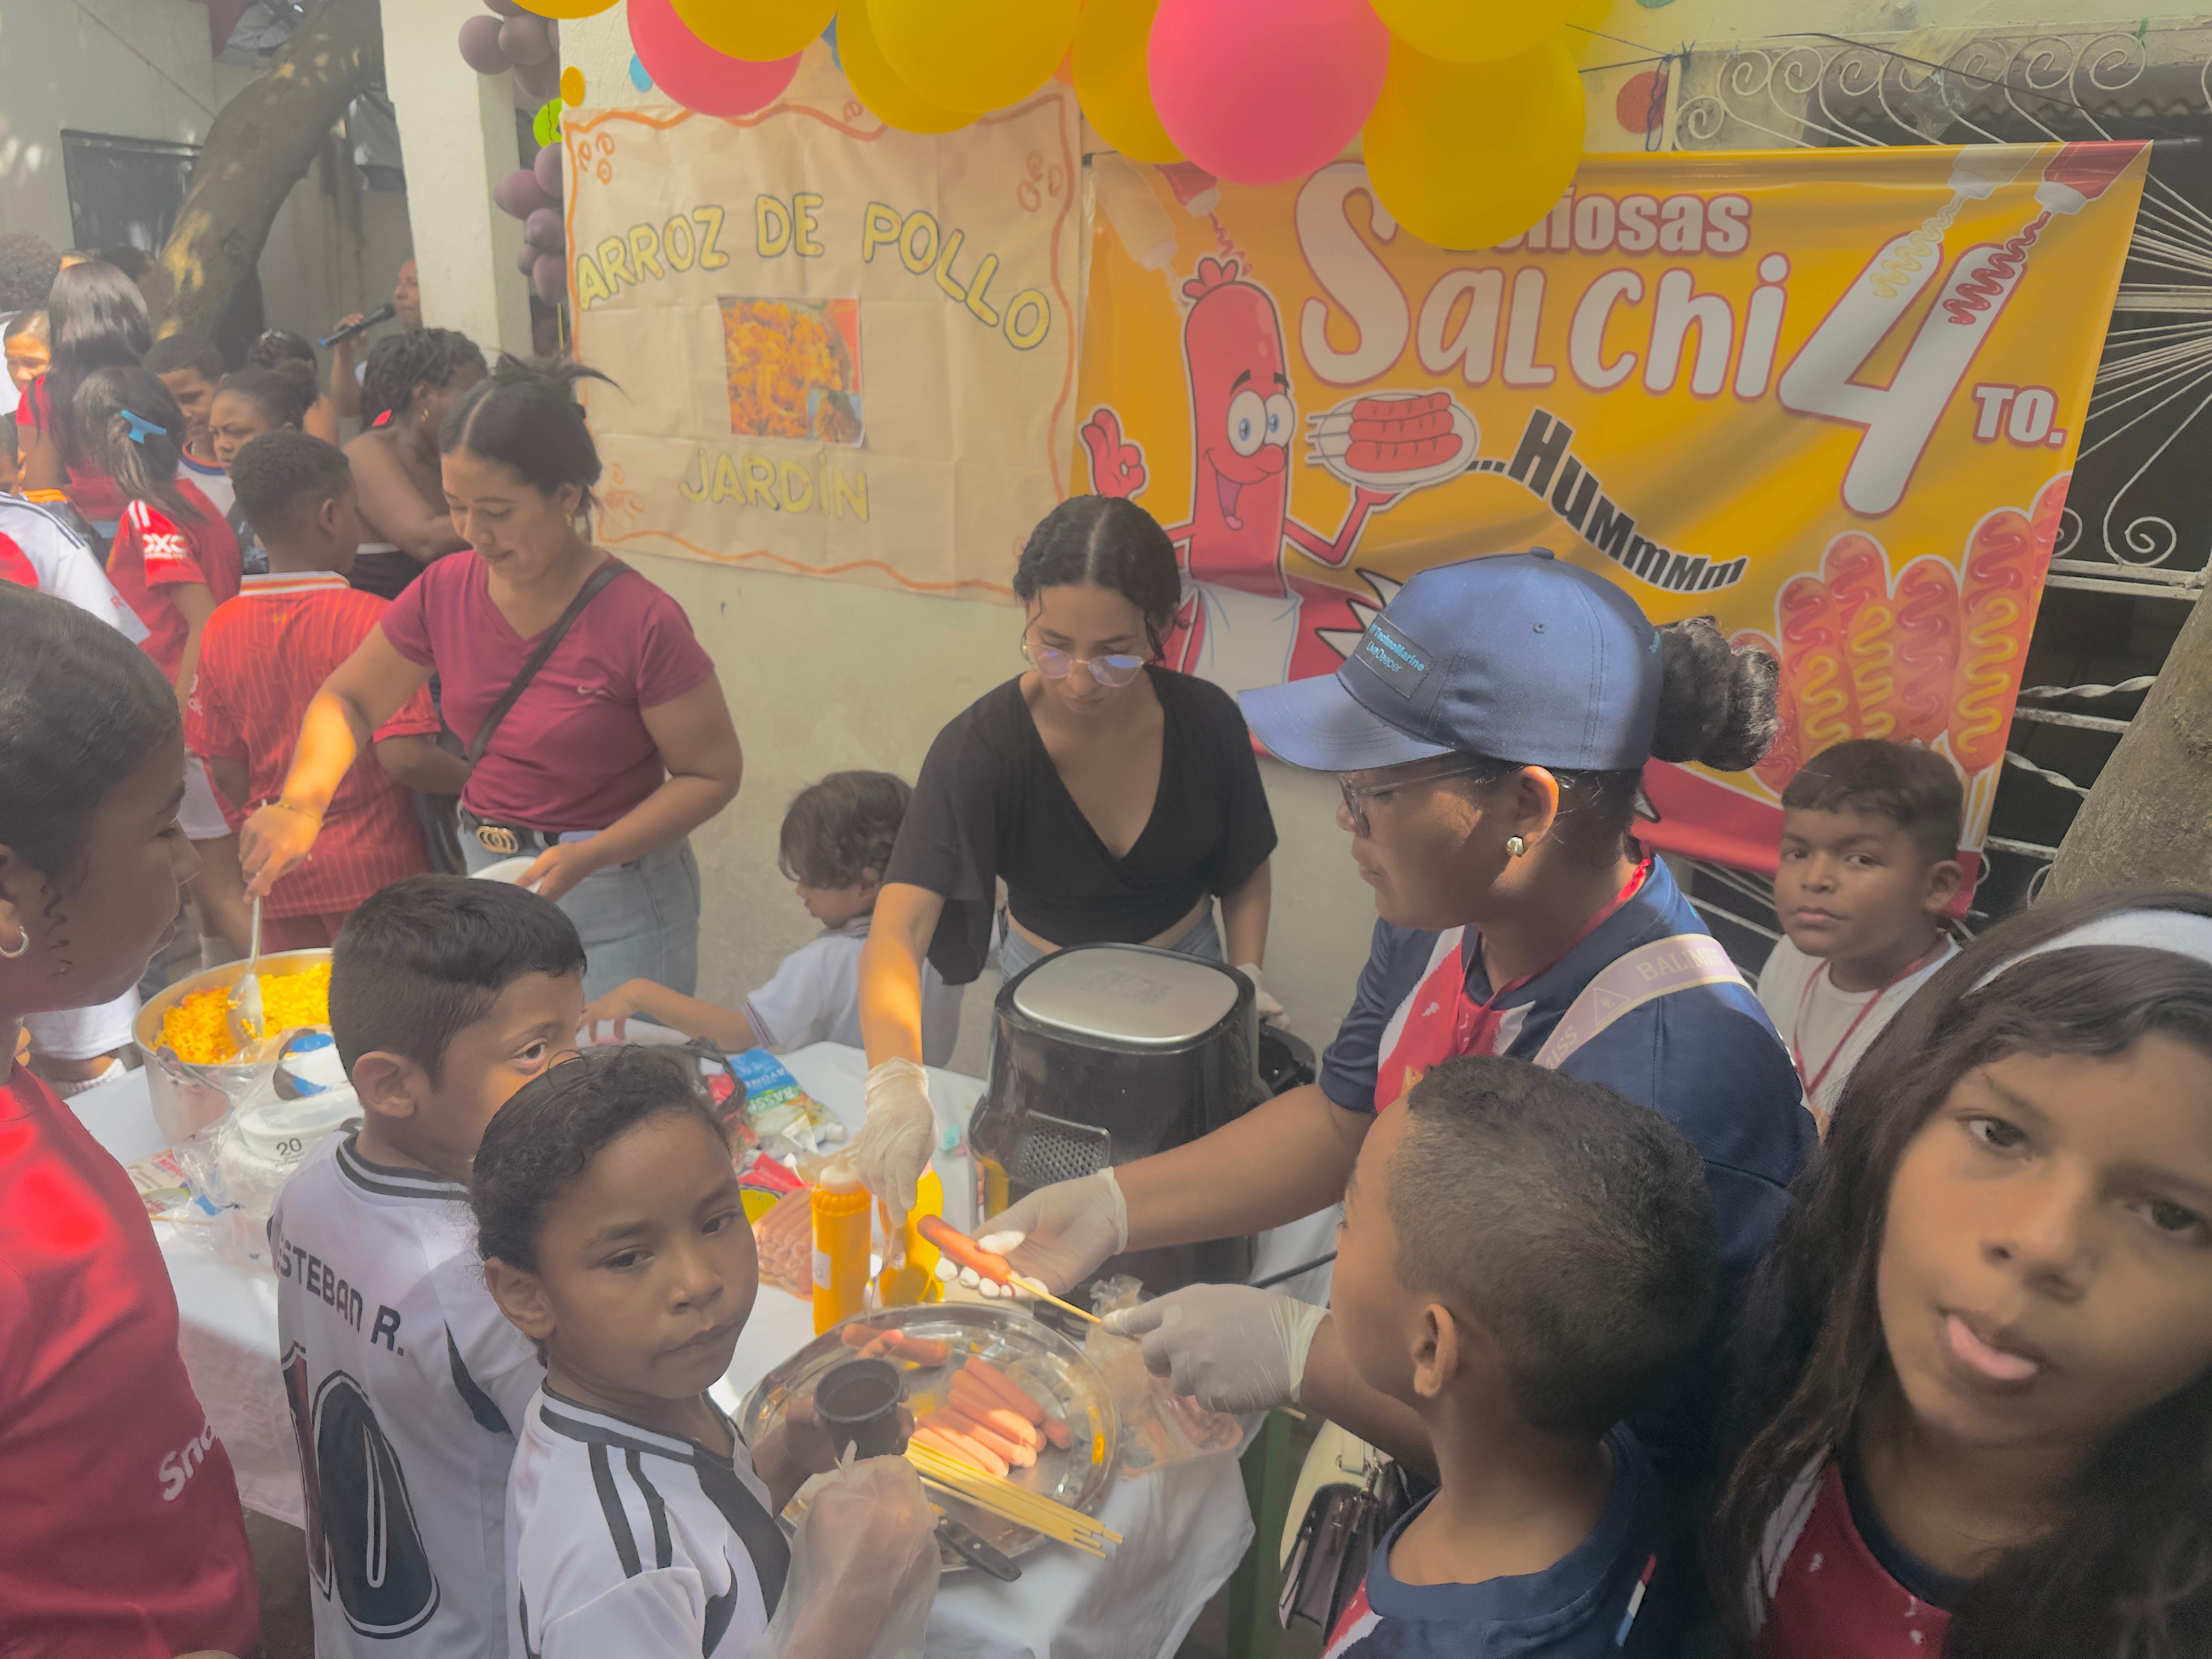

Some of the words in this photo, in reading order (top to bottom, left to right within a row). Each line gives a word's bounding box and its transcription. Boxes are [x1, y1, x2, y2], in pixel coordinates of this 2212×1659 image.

[576, 206, 730, 311] ARROZ
[755, 192, 825, 258] DE
[862, 201, 1051, 351] POLLO
[1776, 230, 2029, 520] 4
[276, 1137, 302, 1156] 20
[370, 1304, 404, 1357] R.
